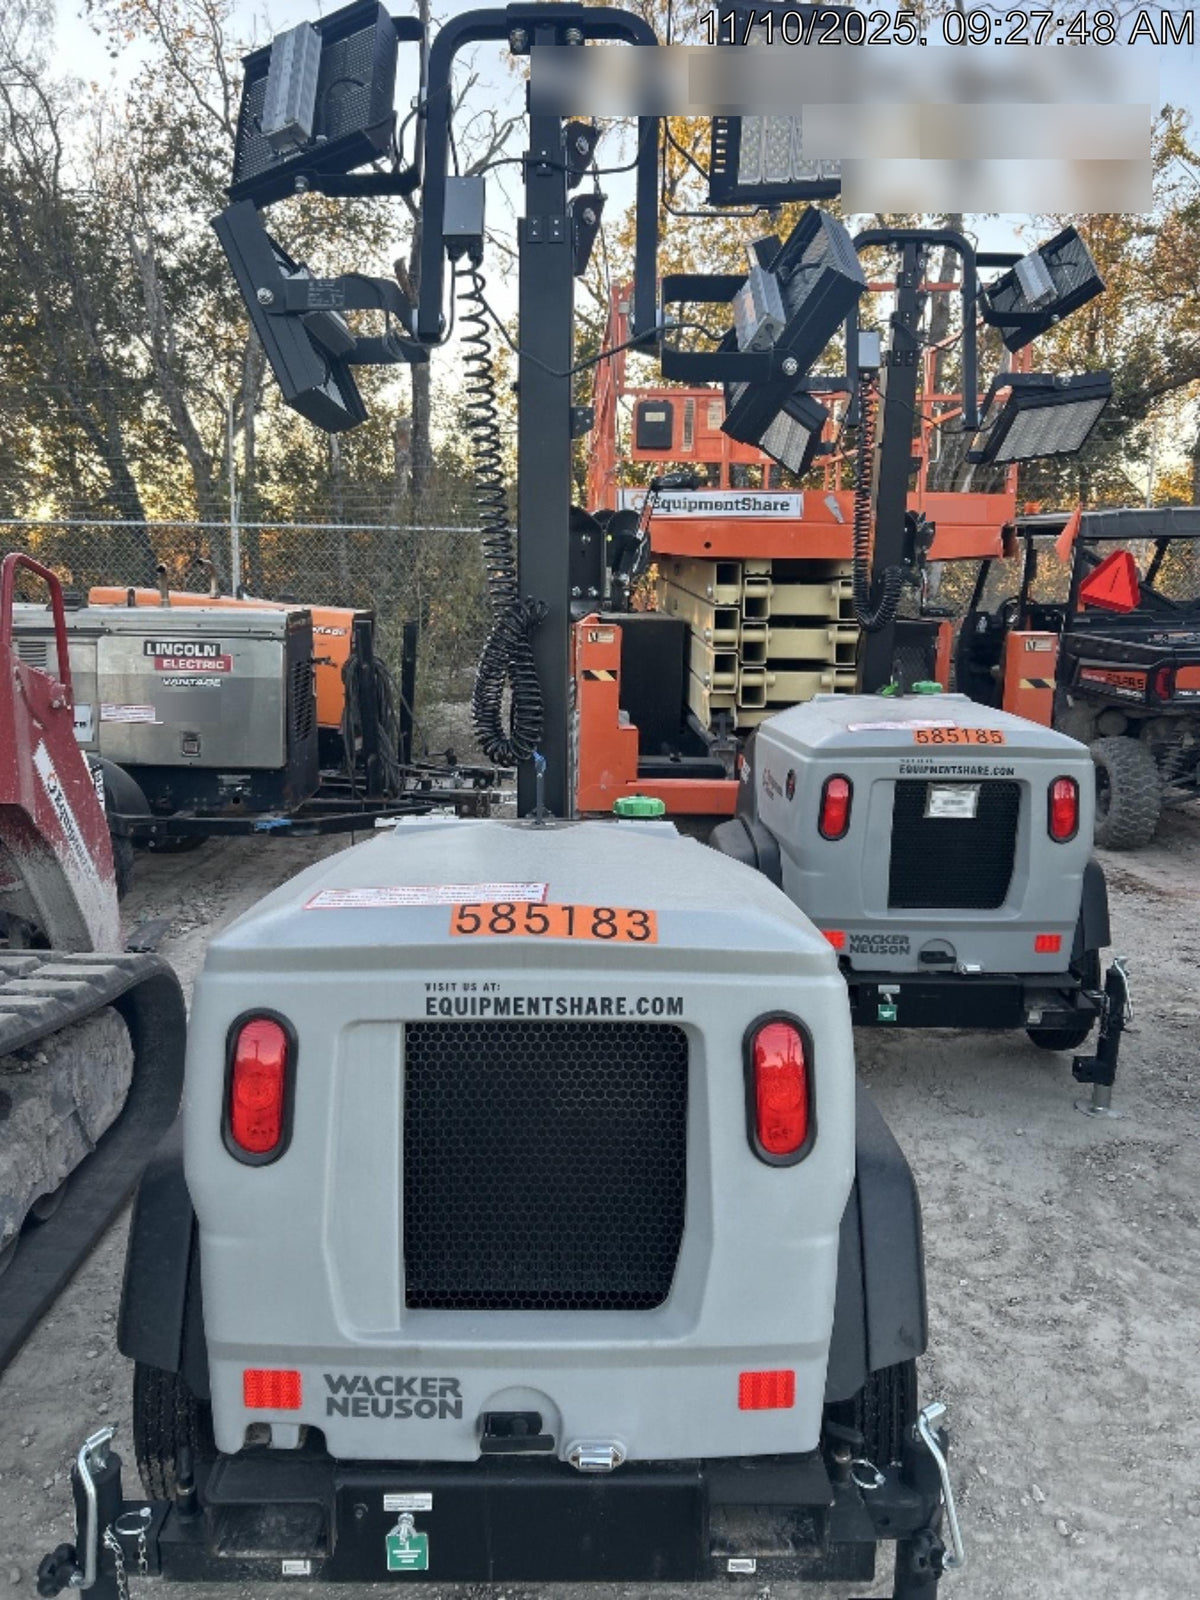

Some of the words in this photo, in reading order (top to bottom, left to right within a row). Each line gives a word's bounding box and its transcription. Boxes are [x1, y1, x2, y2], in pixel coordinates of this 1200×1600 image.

[652, 496, 790, 513] EquipmentShare
[146, 642, 217, 657] LINCOLN
[162, 658, 225, 670] ELECTRIC
[162, 678, 222, 687] VANTAGE
[916, 729, 1003, 744] 585185
[899, 764, 1015, 777] EQUIPMENTSHARE.COM
[456, 902, 651, 941] 585183
[849, 934, 910, 945] WACKER
[849, 944, 911, 955] NEUSON
[425, 982, 457, 992] VISIT
[463, 982, 477, 992] US
[483, 982, 501, 992] AT:
[425, 996, 684, 1017] EQUIPMENTSHARE.COM
[322, 1373, 463, 1397] WACKER
[325, 1397, 463, 1419] NEUSON
